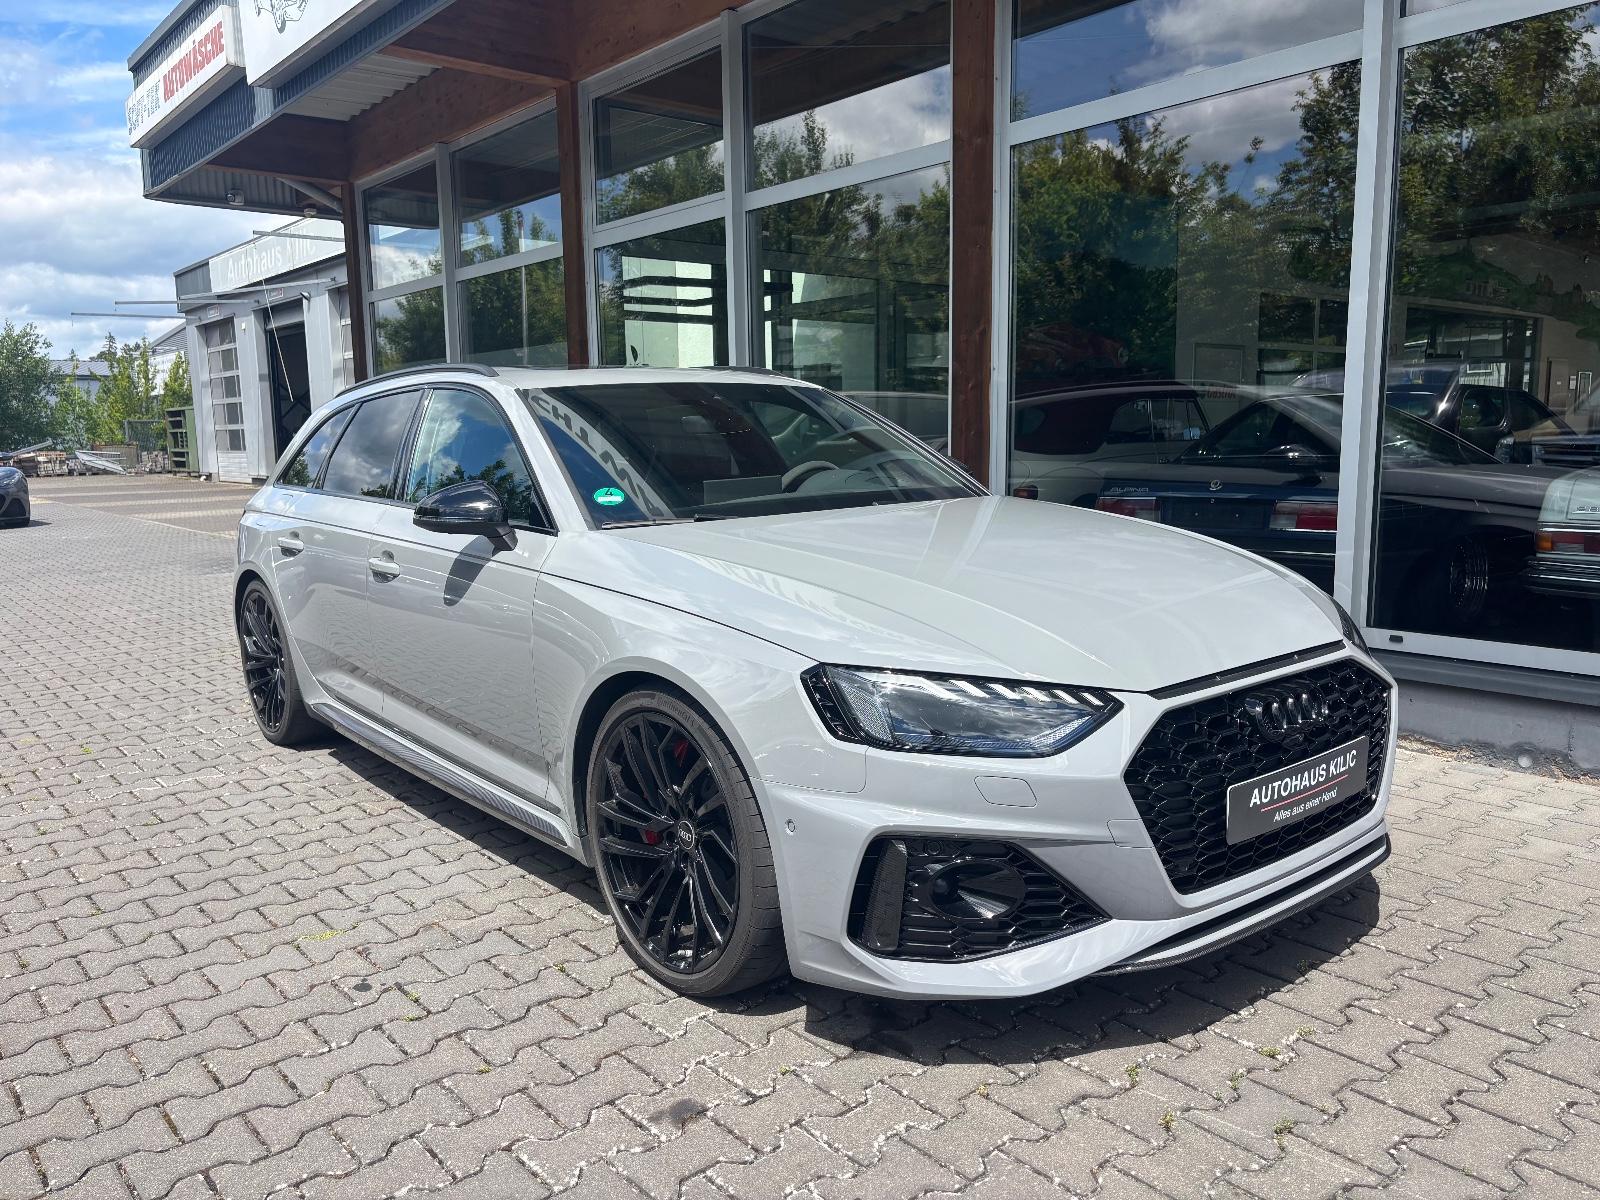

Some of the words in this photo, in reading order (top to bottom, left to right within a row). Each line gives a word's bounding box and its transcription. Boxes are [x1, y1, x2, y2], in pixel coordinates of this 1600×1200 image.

[163, 21, 225, 103] AUTOWÄSCHE
[227, 245, 282, 282] Autohaus
[605, 488, 614, 497] 4
[1249, 763, 1327, 808] AUTOHAUS
[1329, 749, 1357, 778] KILIC
[1273, 809, 1292, 822] Alles
[1291, 804, 1305, 816] aus
[1305, 796, 1322, 809] einer
[1321, 787, 1338, 802] Hand
